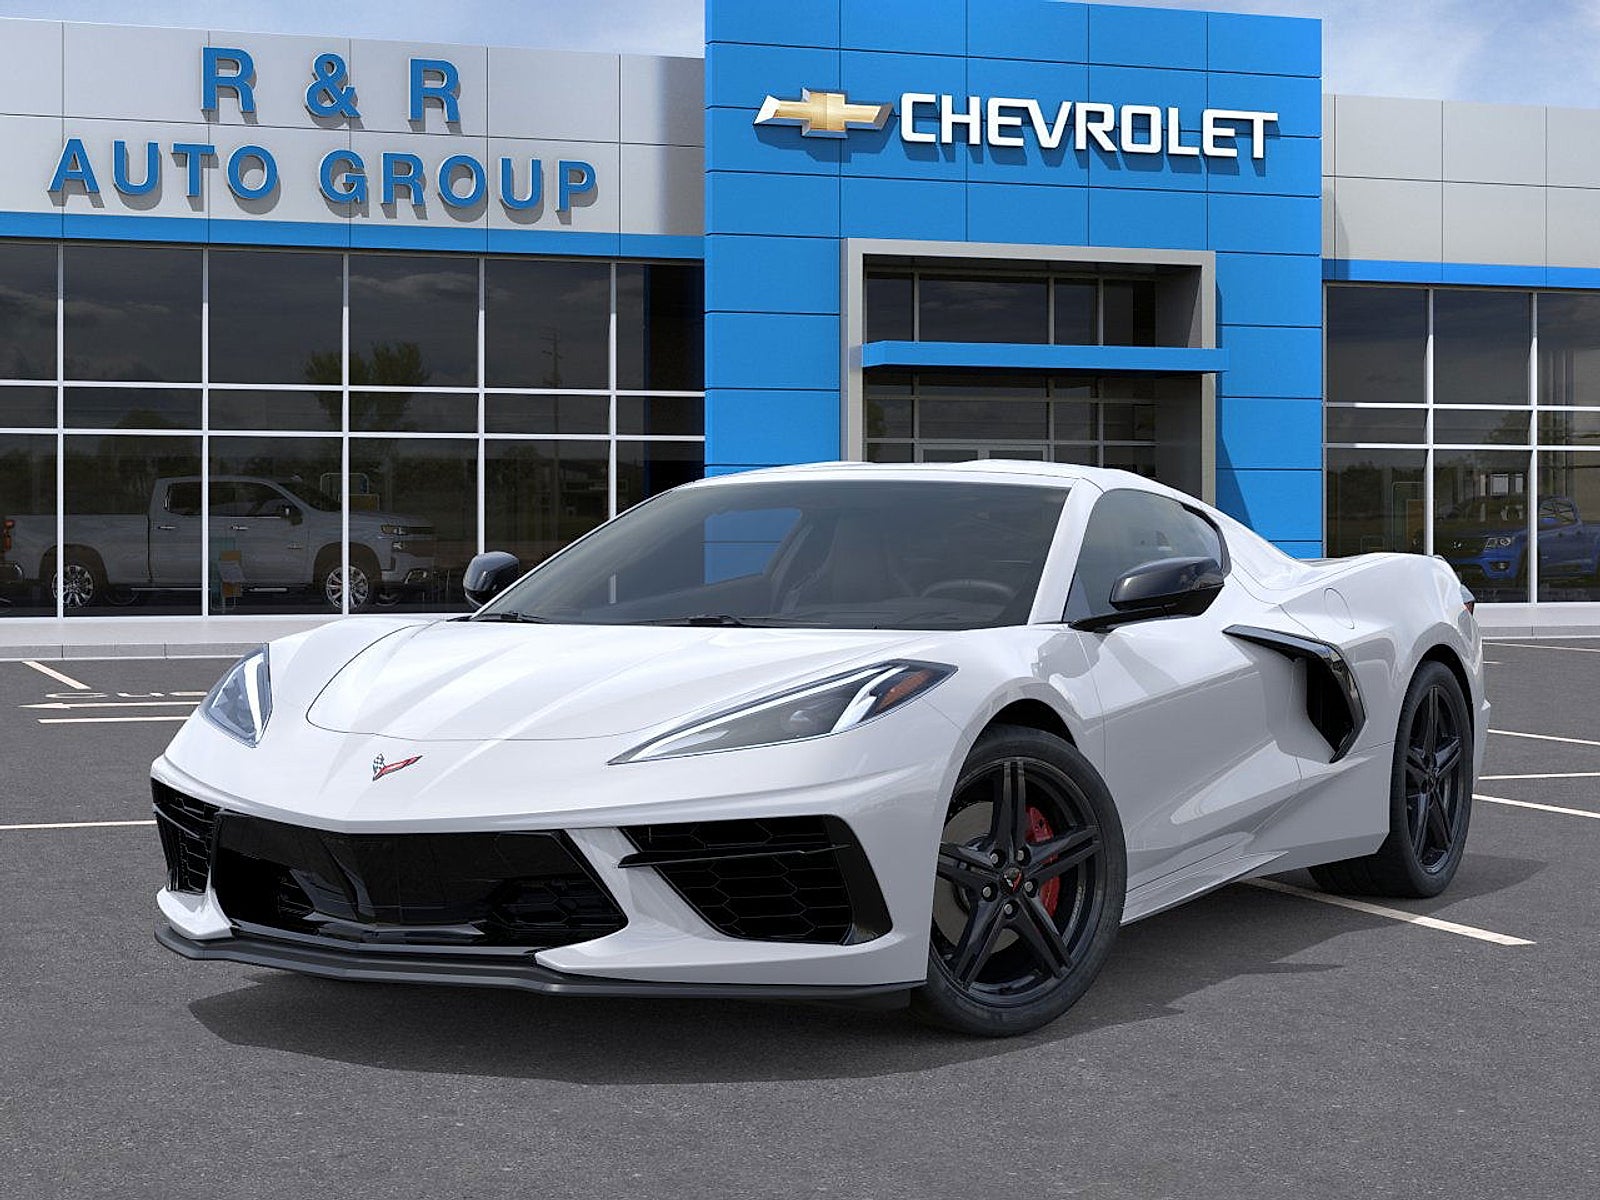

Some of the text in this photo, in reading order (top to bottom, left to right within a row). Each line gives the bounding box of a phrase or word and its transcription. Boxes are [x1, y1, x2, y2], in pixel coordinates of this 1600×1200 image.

[202, 46, 460, 122] R & R
[900, 92, 1279, 159] CHEVROLET
[49, 138, 596, 212] AUTO GROUP
